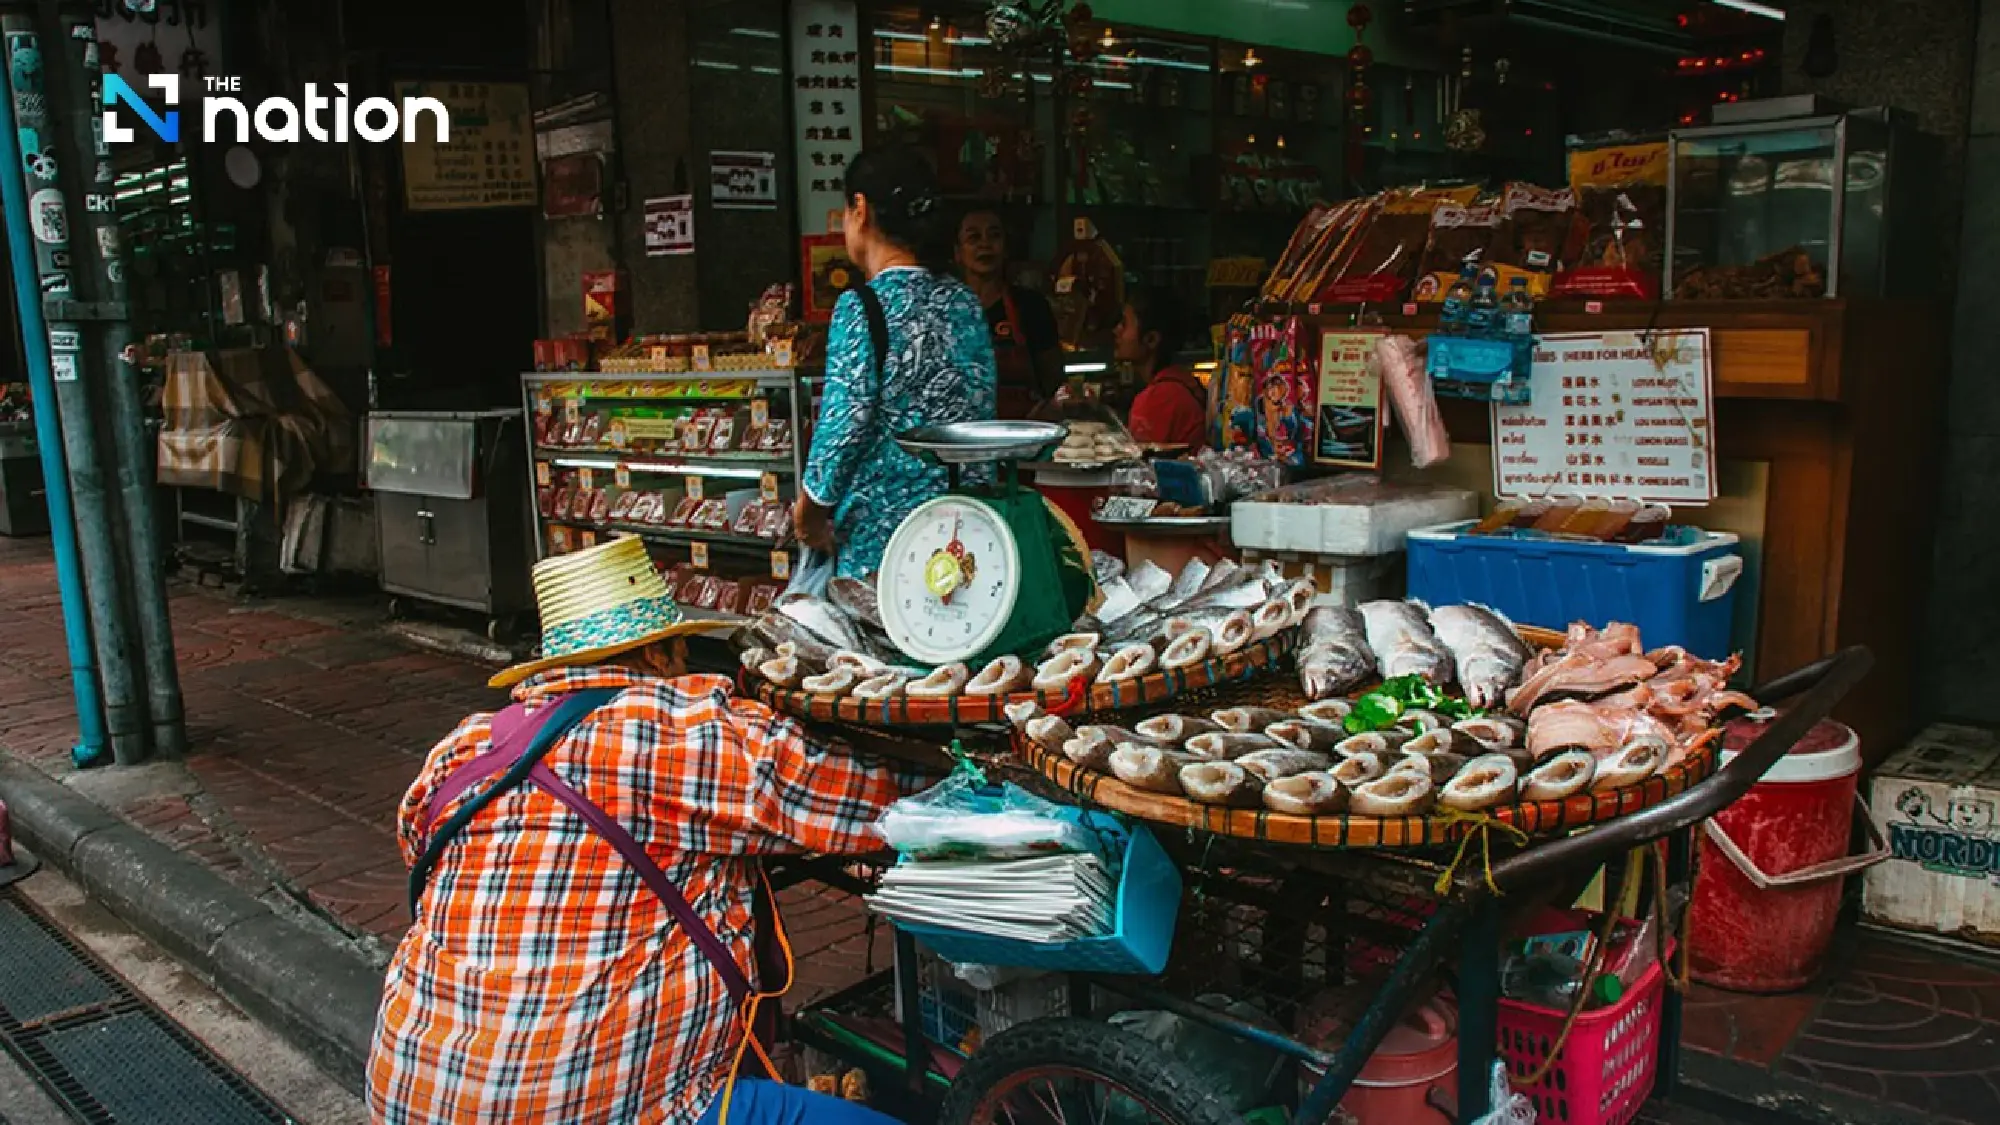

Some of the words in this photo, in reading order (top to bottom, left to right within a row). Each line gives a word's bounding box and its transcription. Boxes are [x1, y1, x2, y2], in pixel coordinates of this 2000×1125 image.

[1597, 348, 1618, 361] FOR
[1634, 437, 1662, 446] LEMON
[1671, 477, 1690, 487] DATE
